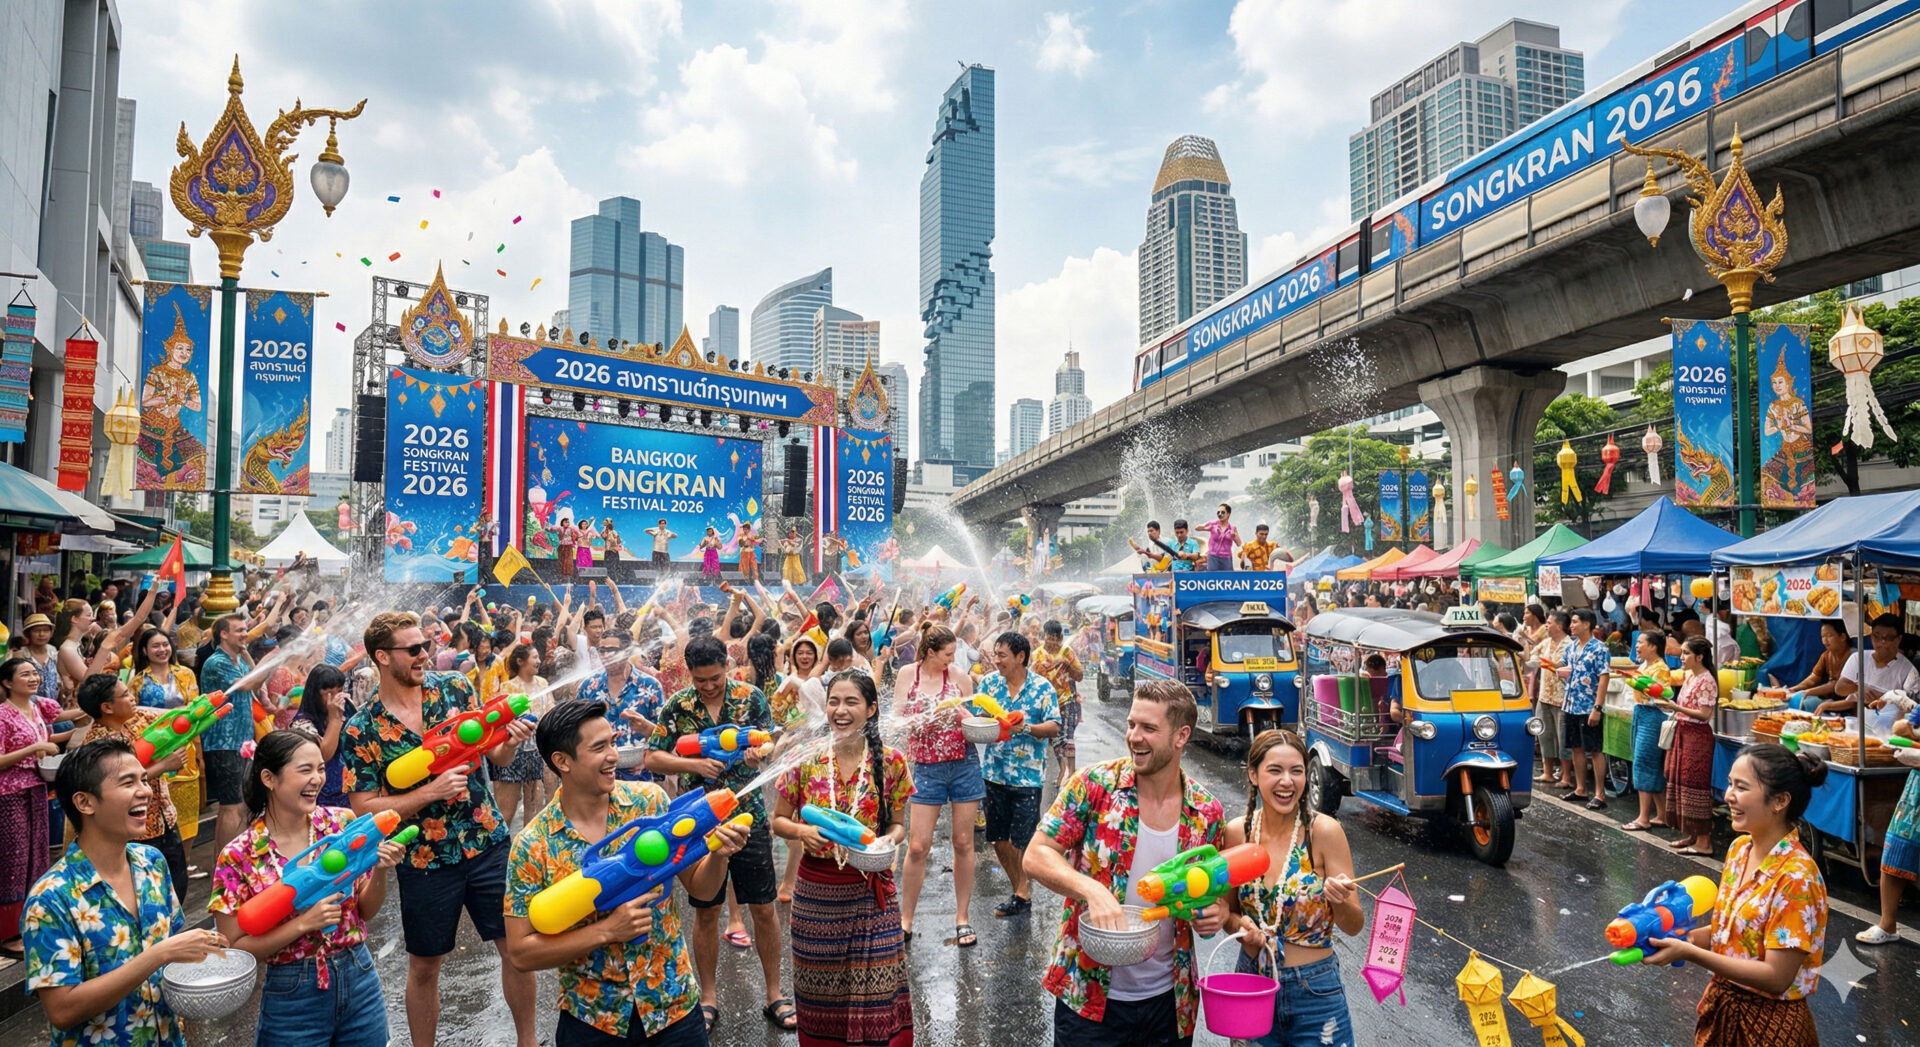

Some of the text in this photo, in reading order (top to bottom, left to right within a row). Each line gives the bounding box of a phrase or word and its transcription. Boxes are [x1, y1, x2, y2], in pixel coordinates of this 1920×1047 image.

[1431, 66, 1702, 230] SONGKRAN 2026
[1193, 266, 1320, 352] SONGKRAN 2026
[249, 339, 307, 360] 2026
[249, 360, 306, 373] สงกรานต์
[1678, 365, 1727, 383] 2026
[255, 372, 301, 384] กรุงเทพฯ
[555, 358, 787, 410] 2026 สงกรานต์กรุงเทพฯ
[403, 423, 469, 449] 2026
[403, 447, 470, 462] SONGKRAN
[611, 447, 698, 470] BANGKOK
[403, 459, 468, 475] FESTIVAL
[402, 473, 468, 497] 2026
[578, 465, 726, 499] SONGKRAN
[847, 468, 885, 487] 2026
[1381, 484, 1399, 492] 2026
[1409, 484, 1427, 492] 2026
[602, 495, 704, 514] FESTIVAL 2026
[847, 495, 886, 506] FESTIVAL
[847, 505, 885, 523] 2026
[1179, 579, 1284, 591] SONGKRAN 2026
[1786, 578, 1812, 591] 2026
[1452, 610, 1479, 621] TAXI
[1379, 945, 1398, 956] 2026
[1478, 1010, 1497, 1022] 2026
